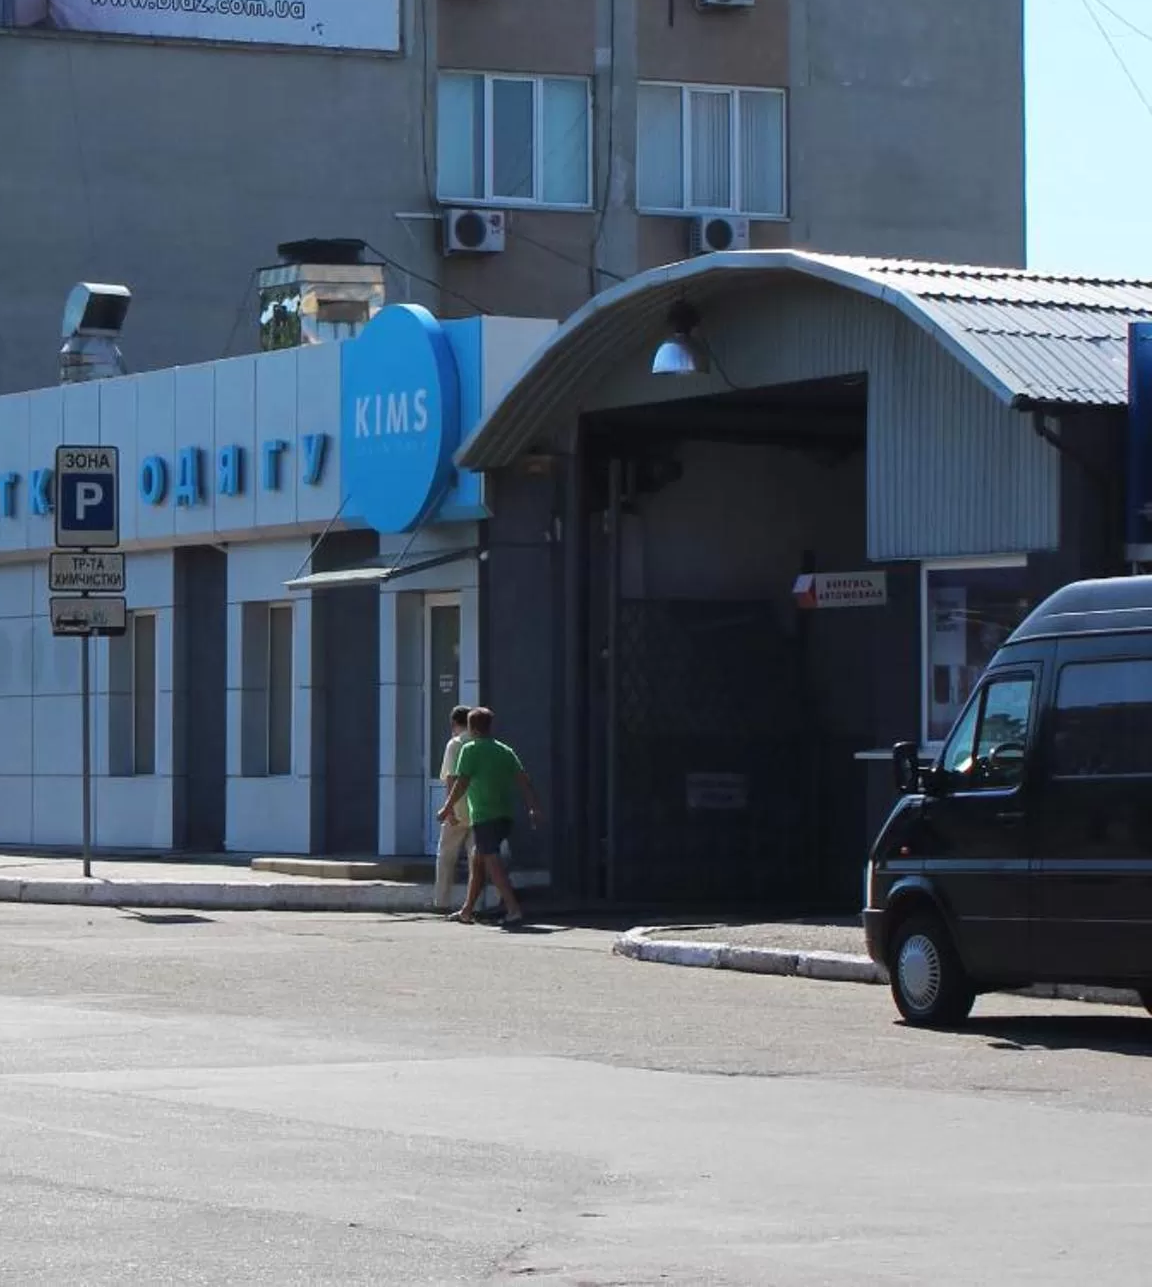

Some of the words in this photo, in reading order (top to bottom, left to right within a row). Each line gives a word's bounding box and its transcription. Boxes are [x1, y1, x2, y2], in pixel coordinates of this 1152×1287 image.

[355, 388, 428, 438] KIMS
[65, 453, 111, 469] ЗОНА
[139, 433, 329, 509] ОДЯГУ
[54, 572, 122, 587] ХИМЧИСТКИ
